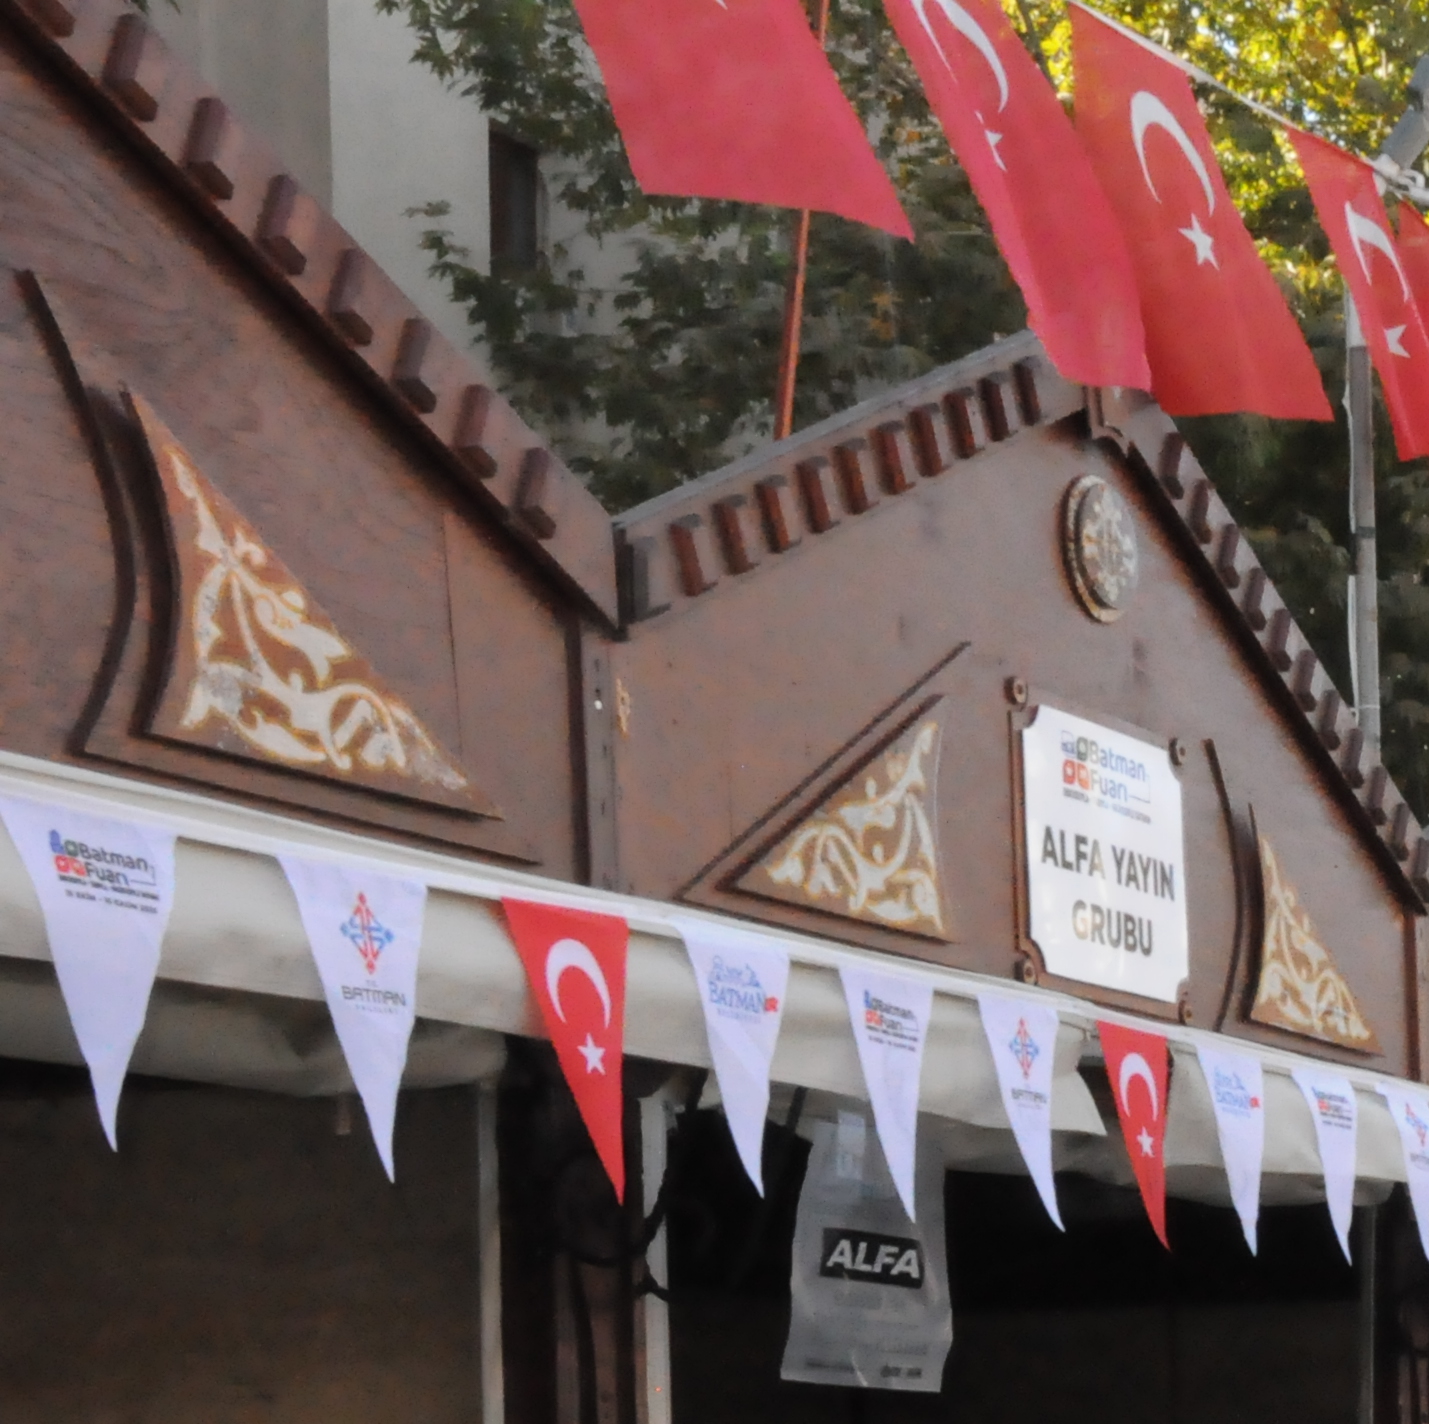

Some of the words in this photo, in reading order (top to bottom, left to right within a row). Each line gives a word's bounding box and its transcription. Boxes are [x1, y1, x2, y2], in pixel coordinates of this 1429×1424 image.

[1089, 740, 1146, 782] Batman
[78, 842, 148, 872] Batman
[1041, 825, 1105, 879] ALFA
[1111, 844, 1175, 901] YAYIN
[1073, 899, 1152, 956] GRUBU
[341, 985, 406, 1006] BATMAN
[708, 981, 765, 1014] BATMAN
[826, 1238, 920, 1279] ALFA
